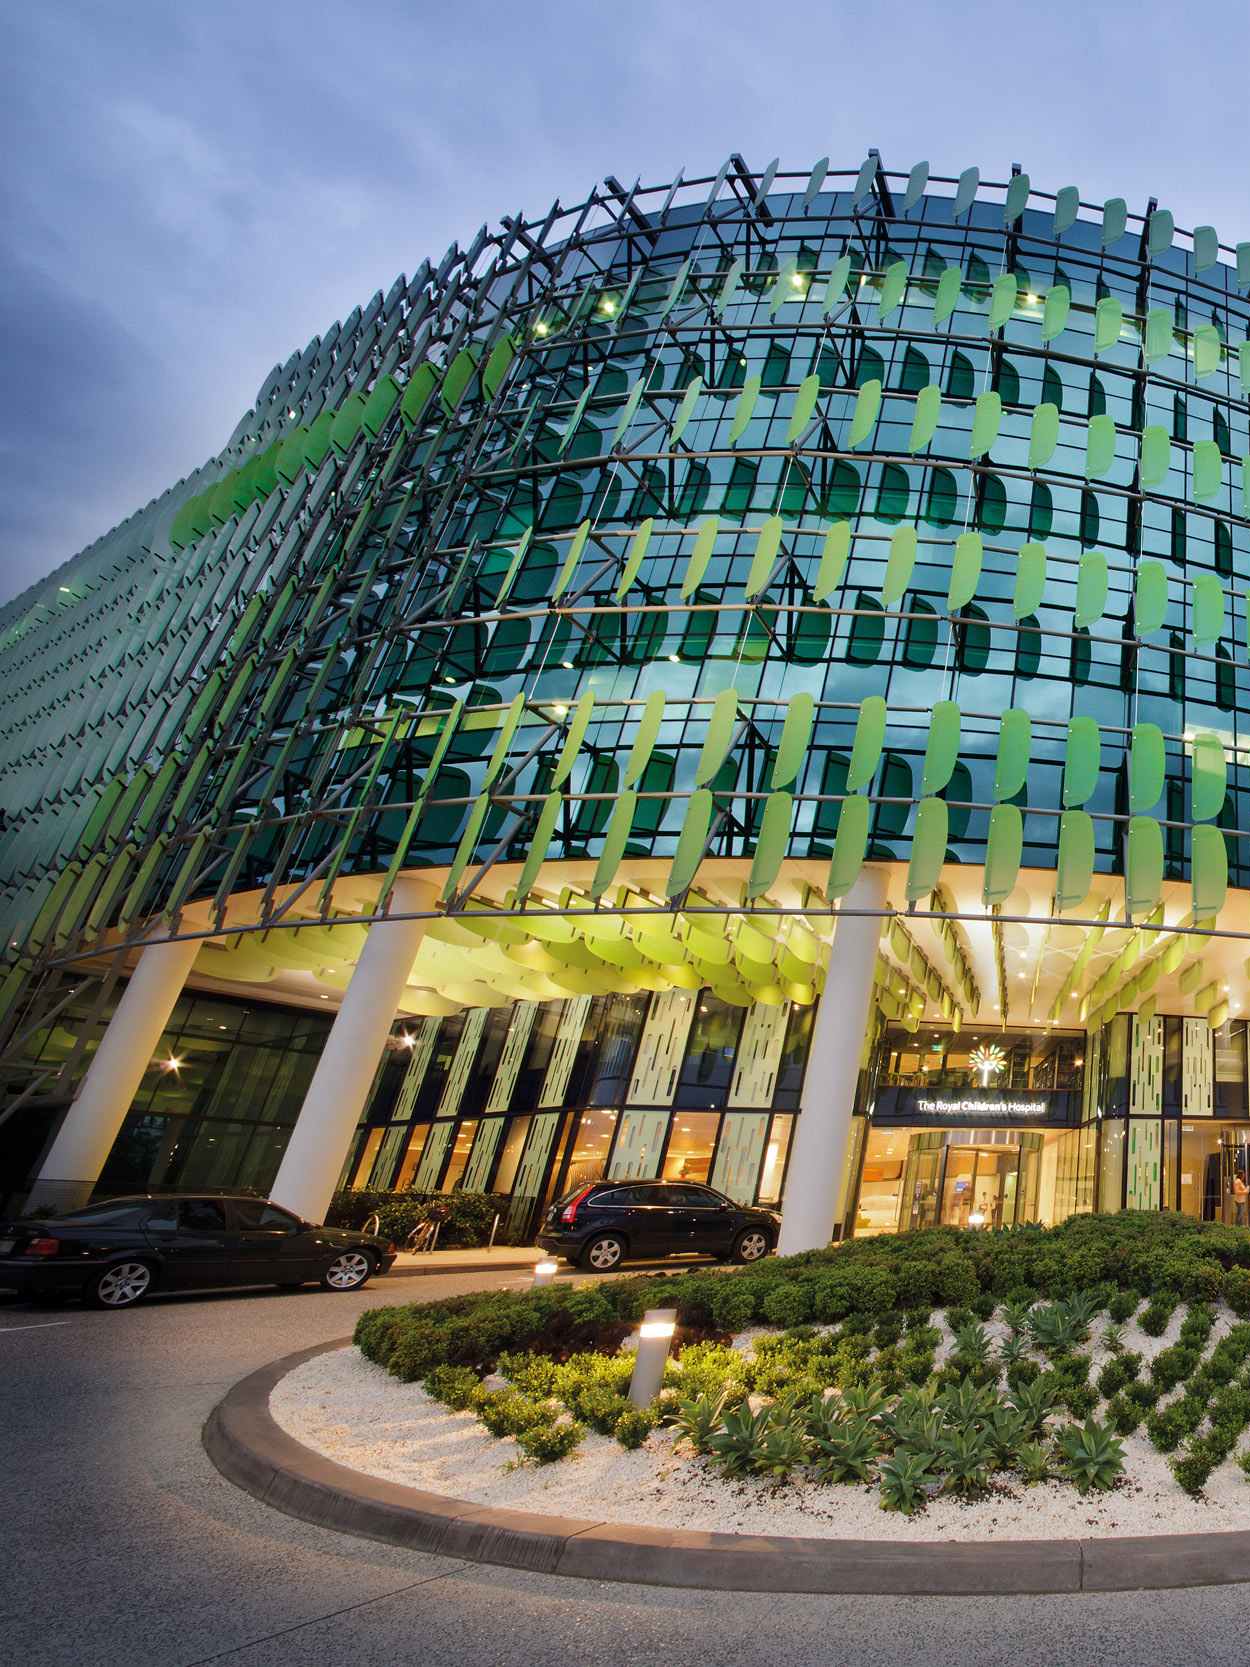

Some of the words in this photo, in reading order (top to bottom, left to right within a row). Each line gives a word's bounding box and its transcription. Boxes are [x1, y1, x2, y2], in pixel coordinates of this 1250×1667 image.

[918, 1100, 936, 1111] The
[936, 1101, 961, 1113] Royal
[961, 1101, 1007, 1112] Children's
[1007, 1101, 1045, 1113] Hospital
